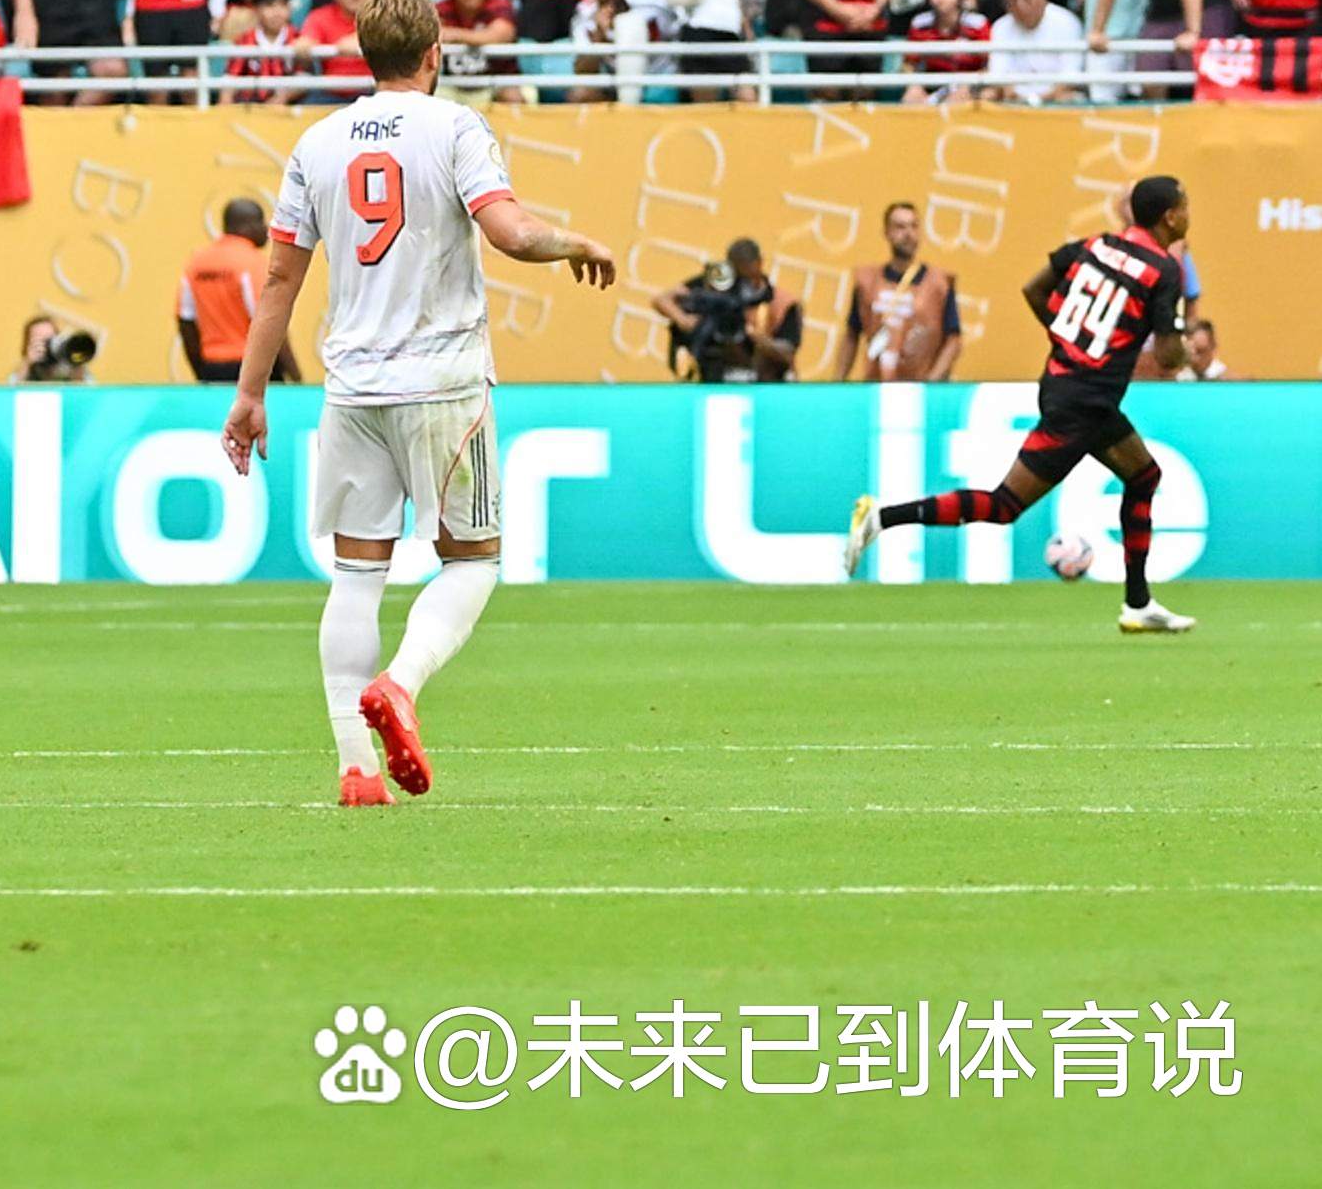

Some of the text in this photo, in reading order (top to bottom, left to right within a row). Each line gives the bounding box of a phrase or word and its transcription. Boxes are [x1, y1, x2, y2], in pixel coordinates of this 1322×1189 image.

[349, 114, 404, 141] KANE
[346, 150, 406, 267] 9
[1049, 261, 1130, 360] 64
[694, 381, 1211, 586] Life
